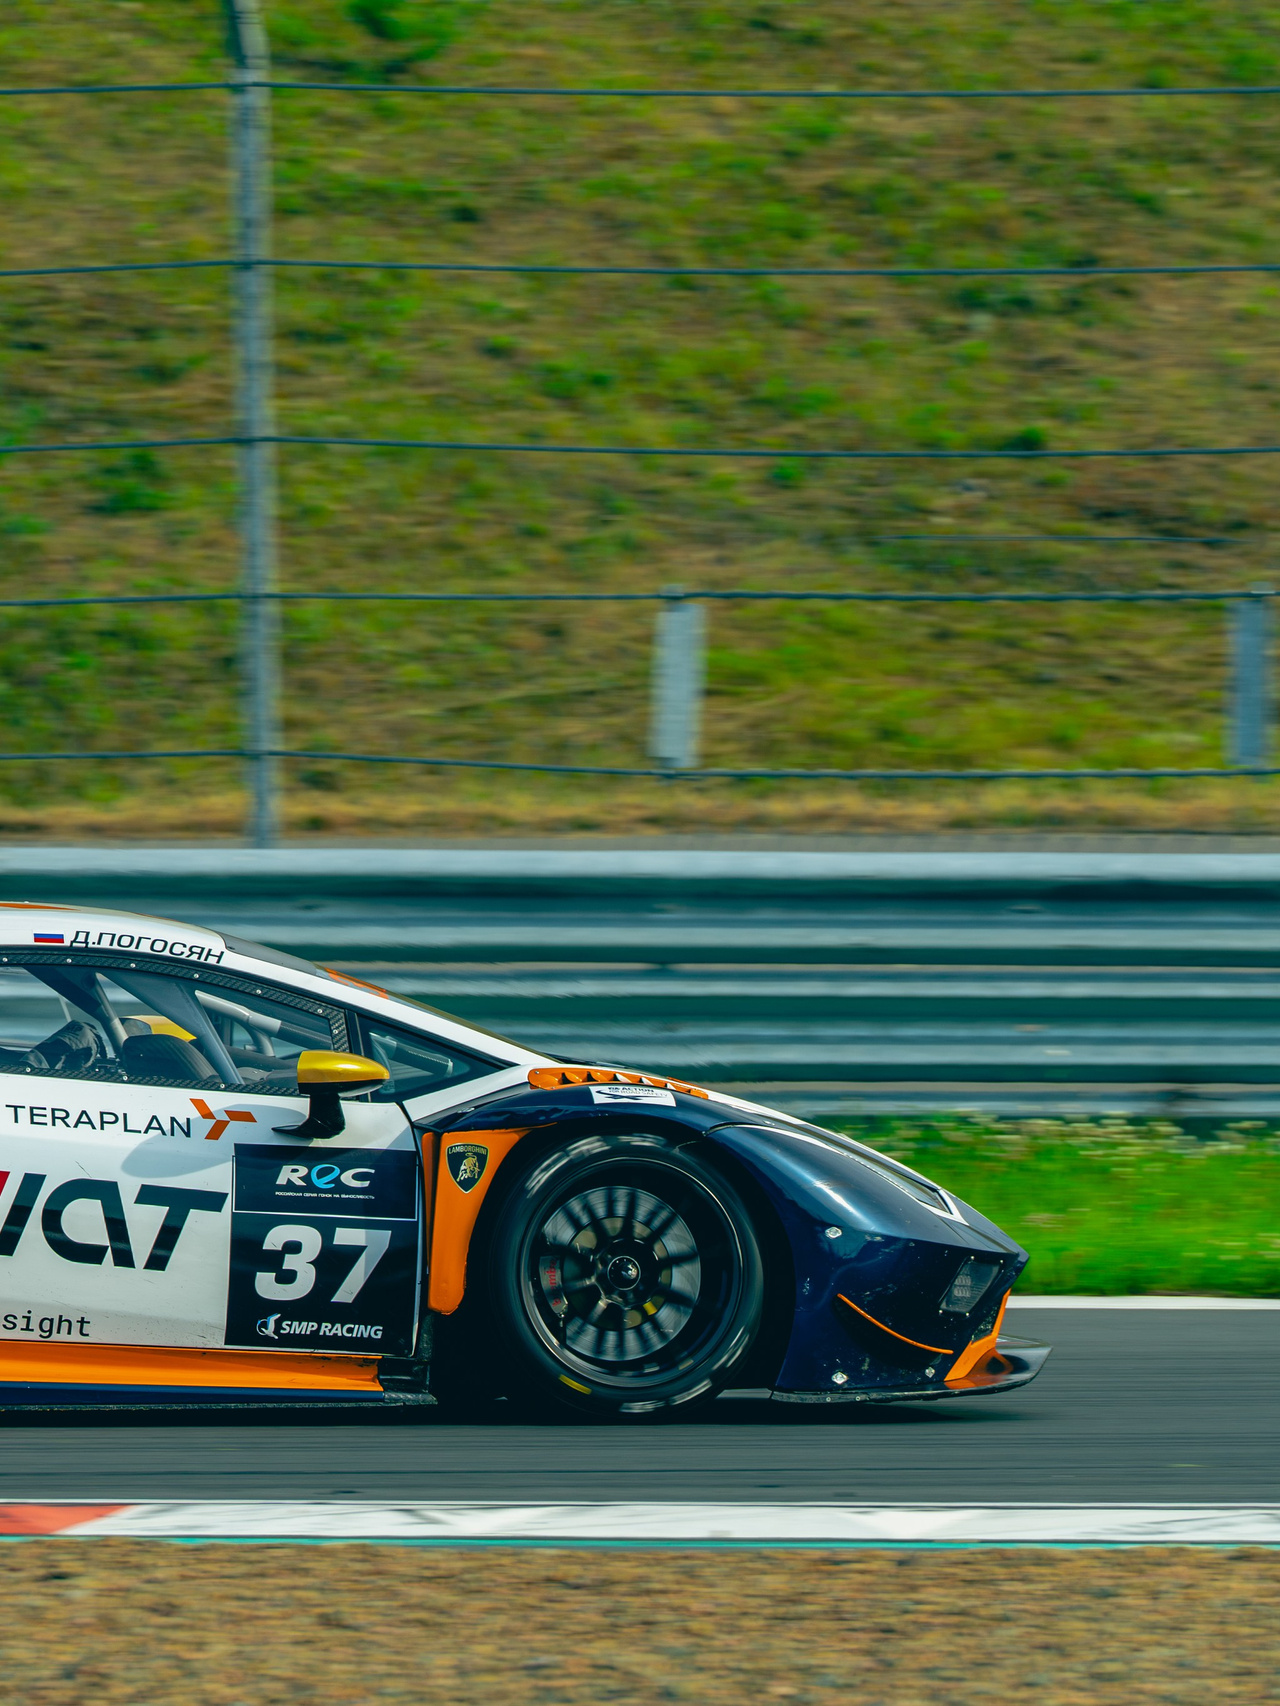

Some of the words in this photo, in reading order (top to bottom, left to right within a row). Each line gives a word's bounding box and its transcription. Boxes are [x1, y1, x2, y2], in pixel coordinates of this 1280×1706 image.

[70, 930, 225, 965] Д.ПОГОСЯН
[5, 1104, 192, 1138] TERAPLAN
[448, 1145, 487, 1155] LAMBORGHINI
[255, 1224, 392, 1303] 37
[280, 1320, 318, 1335] SMP
[319, 1322, 383, 1339] RACING
